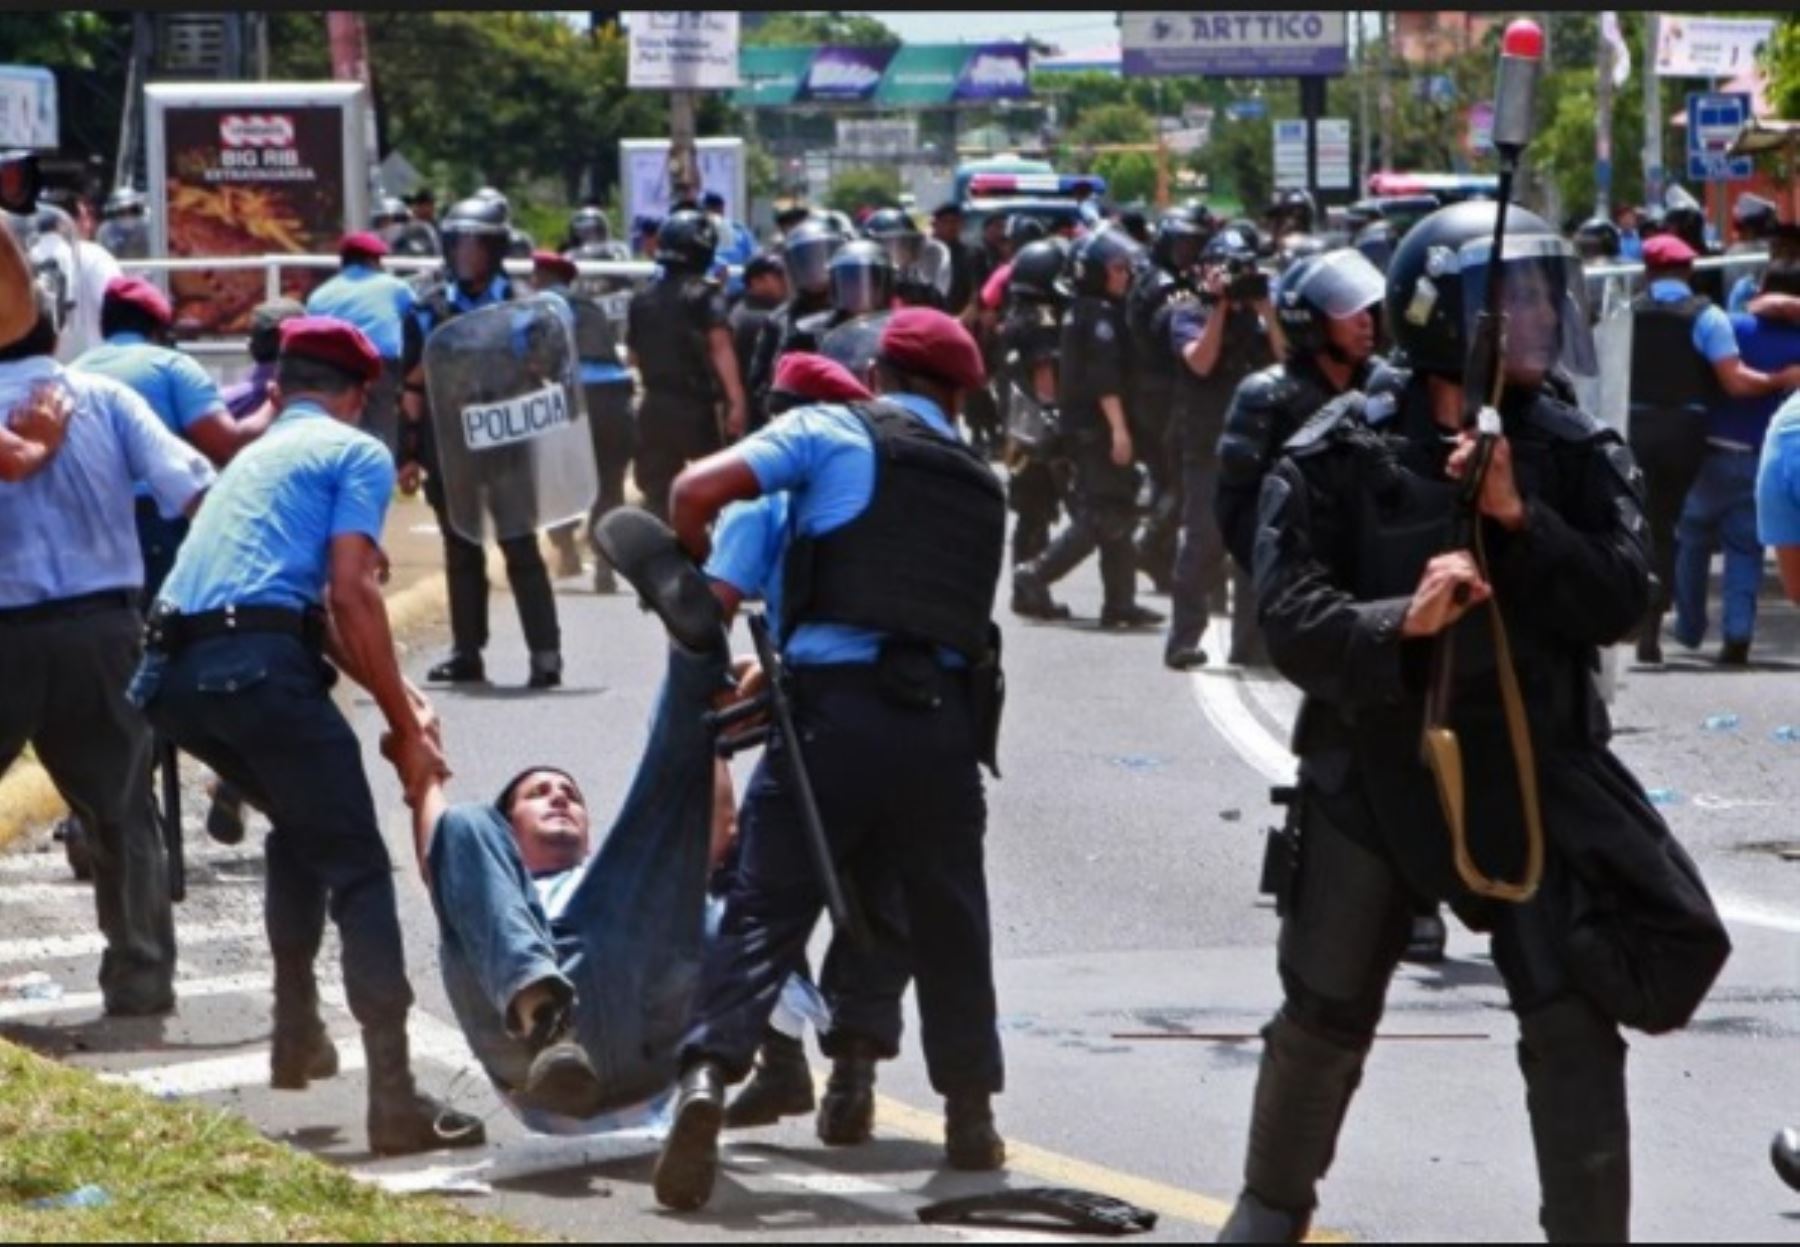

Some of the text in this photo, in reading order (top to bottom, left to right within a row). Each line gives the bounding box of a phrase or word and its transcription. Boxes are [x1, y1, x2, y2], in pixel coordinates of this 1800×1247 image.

[221, 149, 299, 167] BIG RIB
[466, 391, 564, 444] POLICIA
